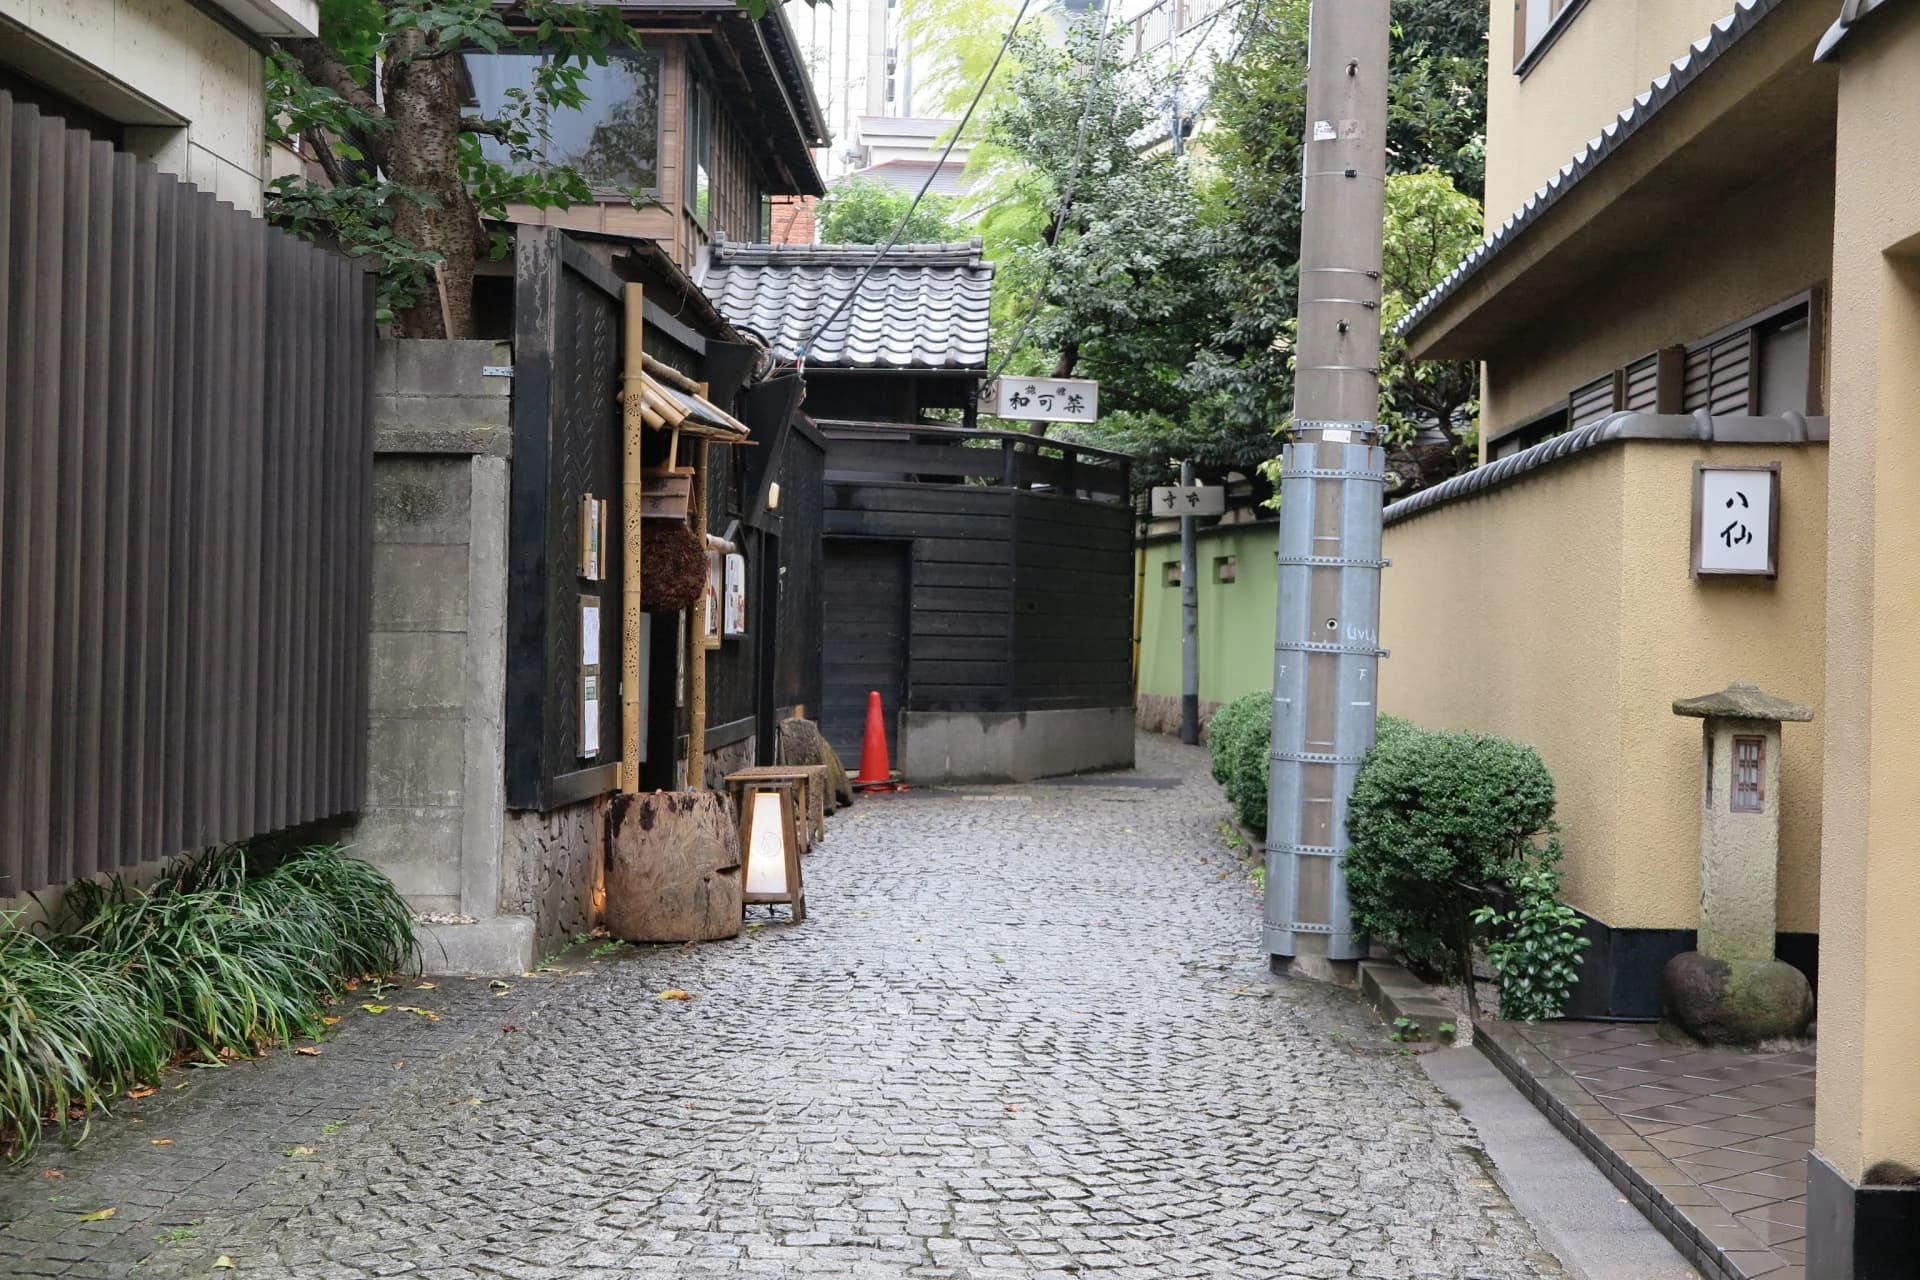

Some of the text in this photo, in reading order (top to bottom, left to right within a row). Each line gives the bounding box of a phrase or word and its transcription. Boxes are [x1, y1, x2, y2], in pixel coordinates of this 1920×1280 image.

[1009, 392, 1085, 413] 和可菜
[1720, 491, 1753, 548] 八仙
